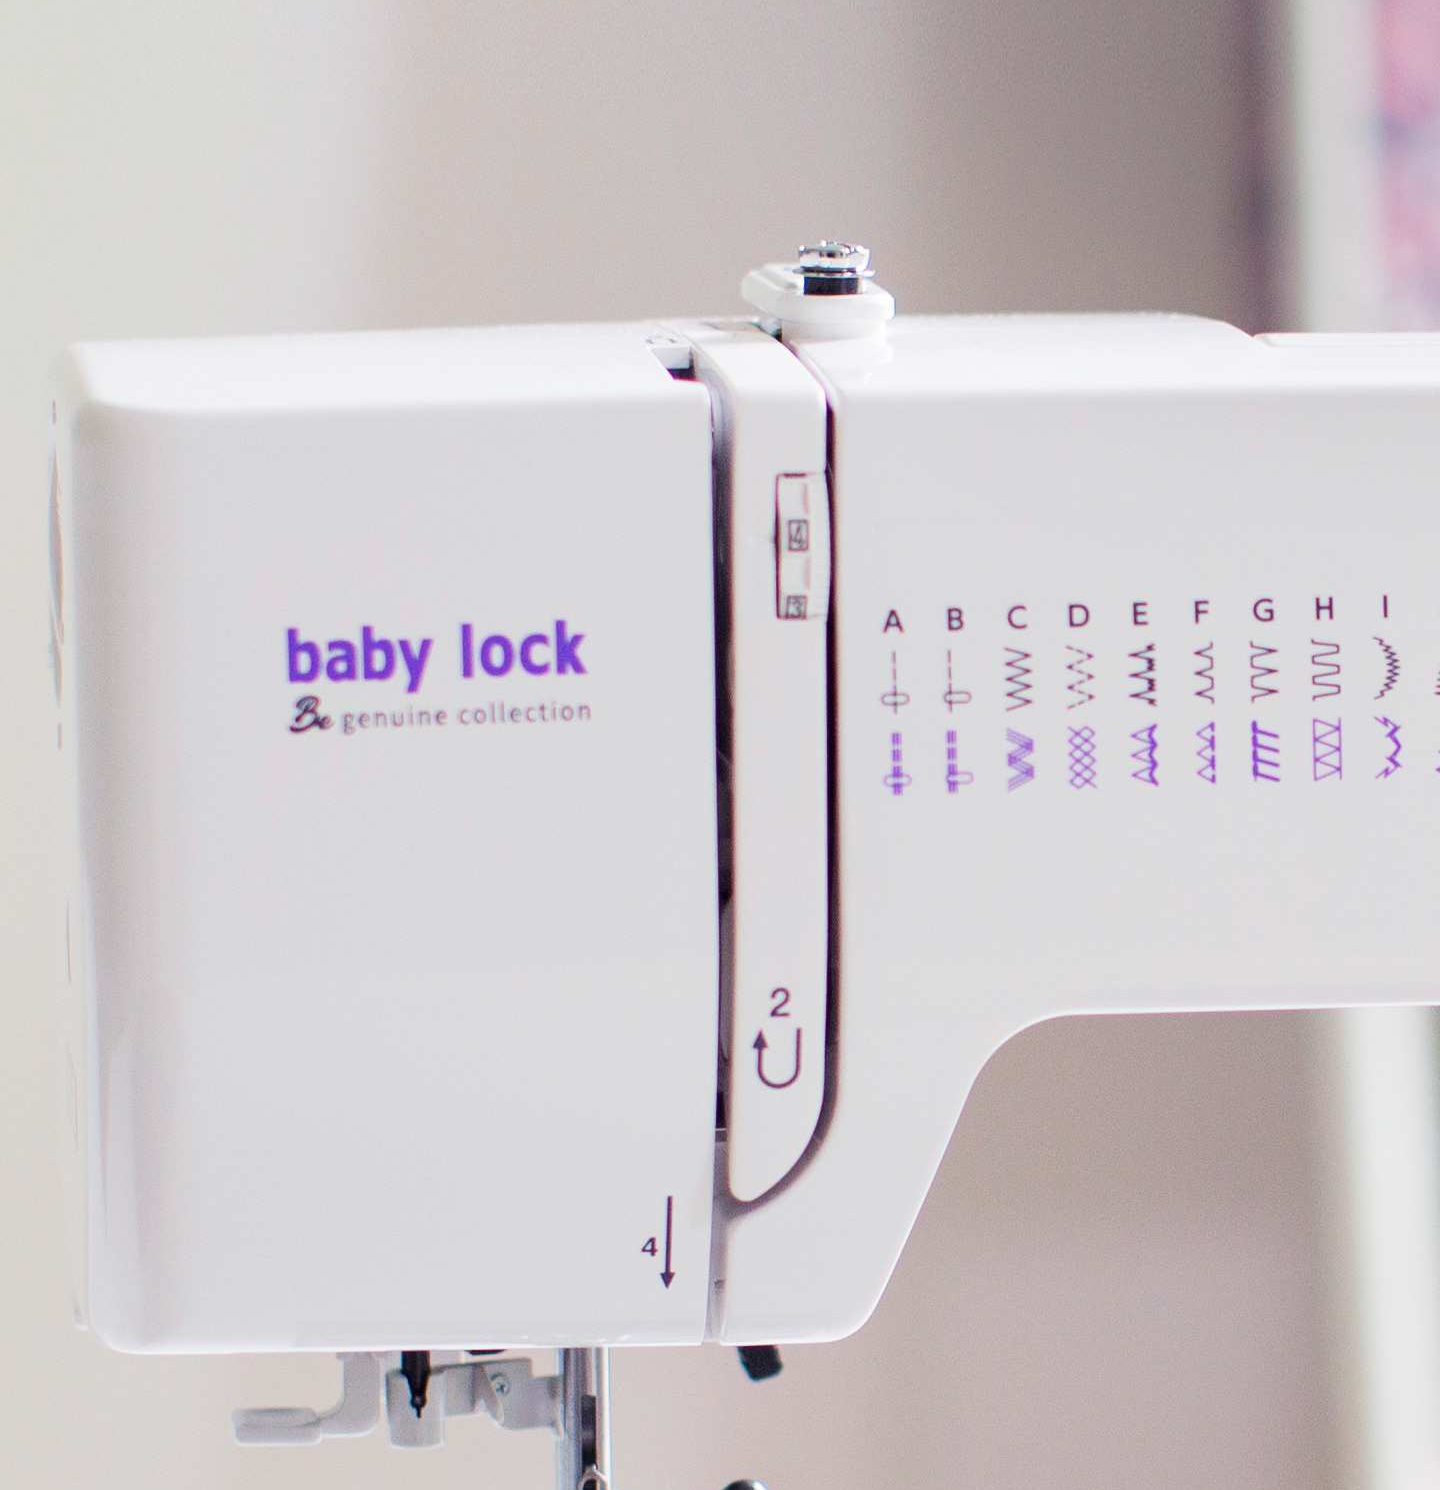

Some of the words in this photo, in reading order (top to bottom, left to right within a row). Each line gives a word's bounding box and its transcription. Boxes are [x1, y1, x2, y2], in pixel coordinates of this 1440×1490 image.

[884, 609, 903, 633] A
[947, 608, 964, 631] B
[1007, 605, 1028, 629] C
[1068, 604, 1090, 628] D
[1132, 602, 1148, 626] E
[1194, 600, 1209, 624] F
[1253, 598, 1274, 622] G
[1315, 597, 1333, 620] H
[1382, 595, 1388, 618] I
[286, 625, 433, 694] baby
[461, 620, 587, 679] lock
[289, 695, 334, 733] Be
[342, 705, 448, 735] genuine
[459, 702, 592, 725] collection
[770, 988, 791, 1017] 2
[641, 1237, 659, 1257] 4
